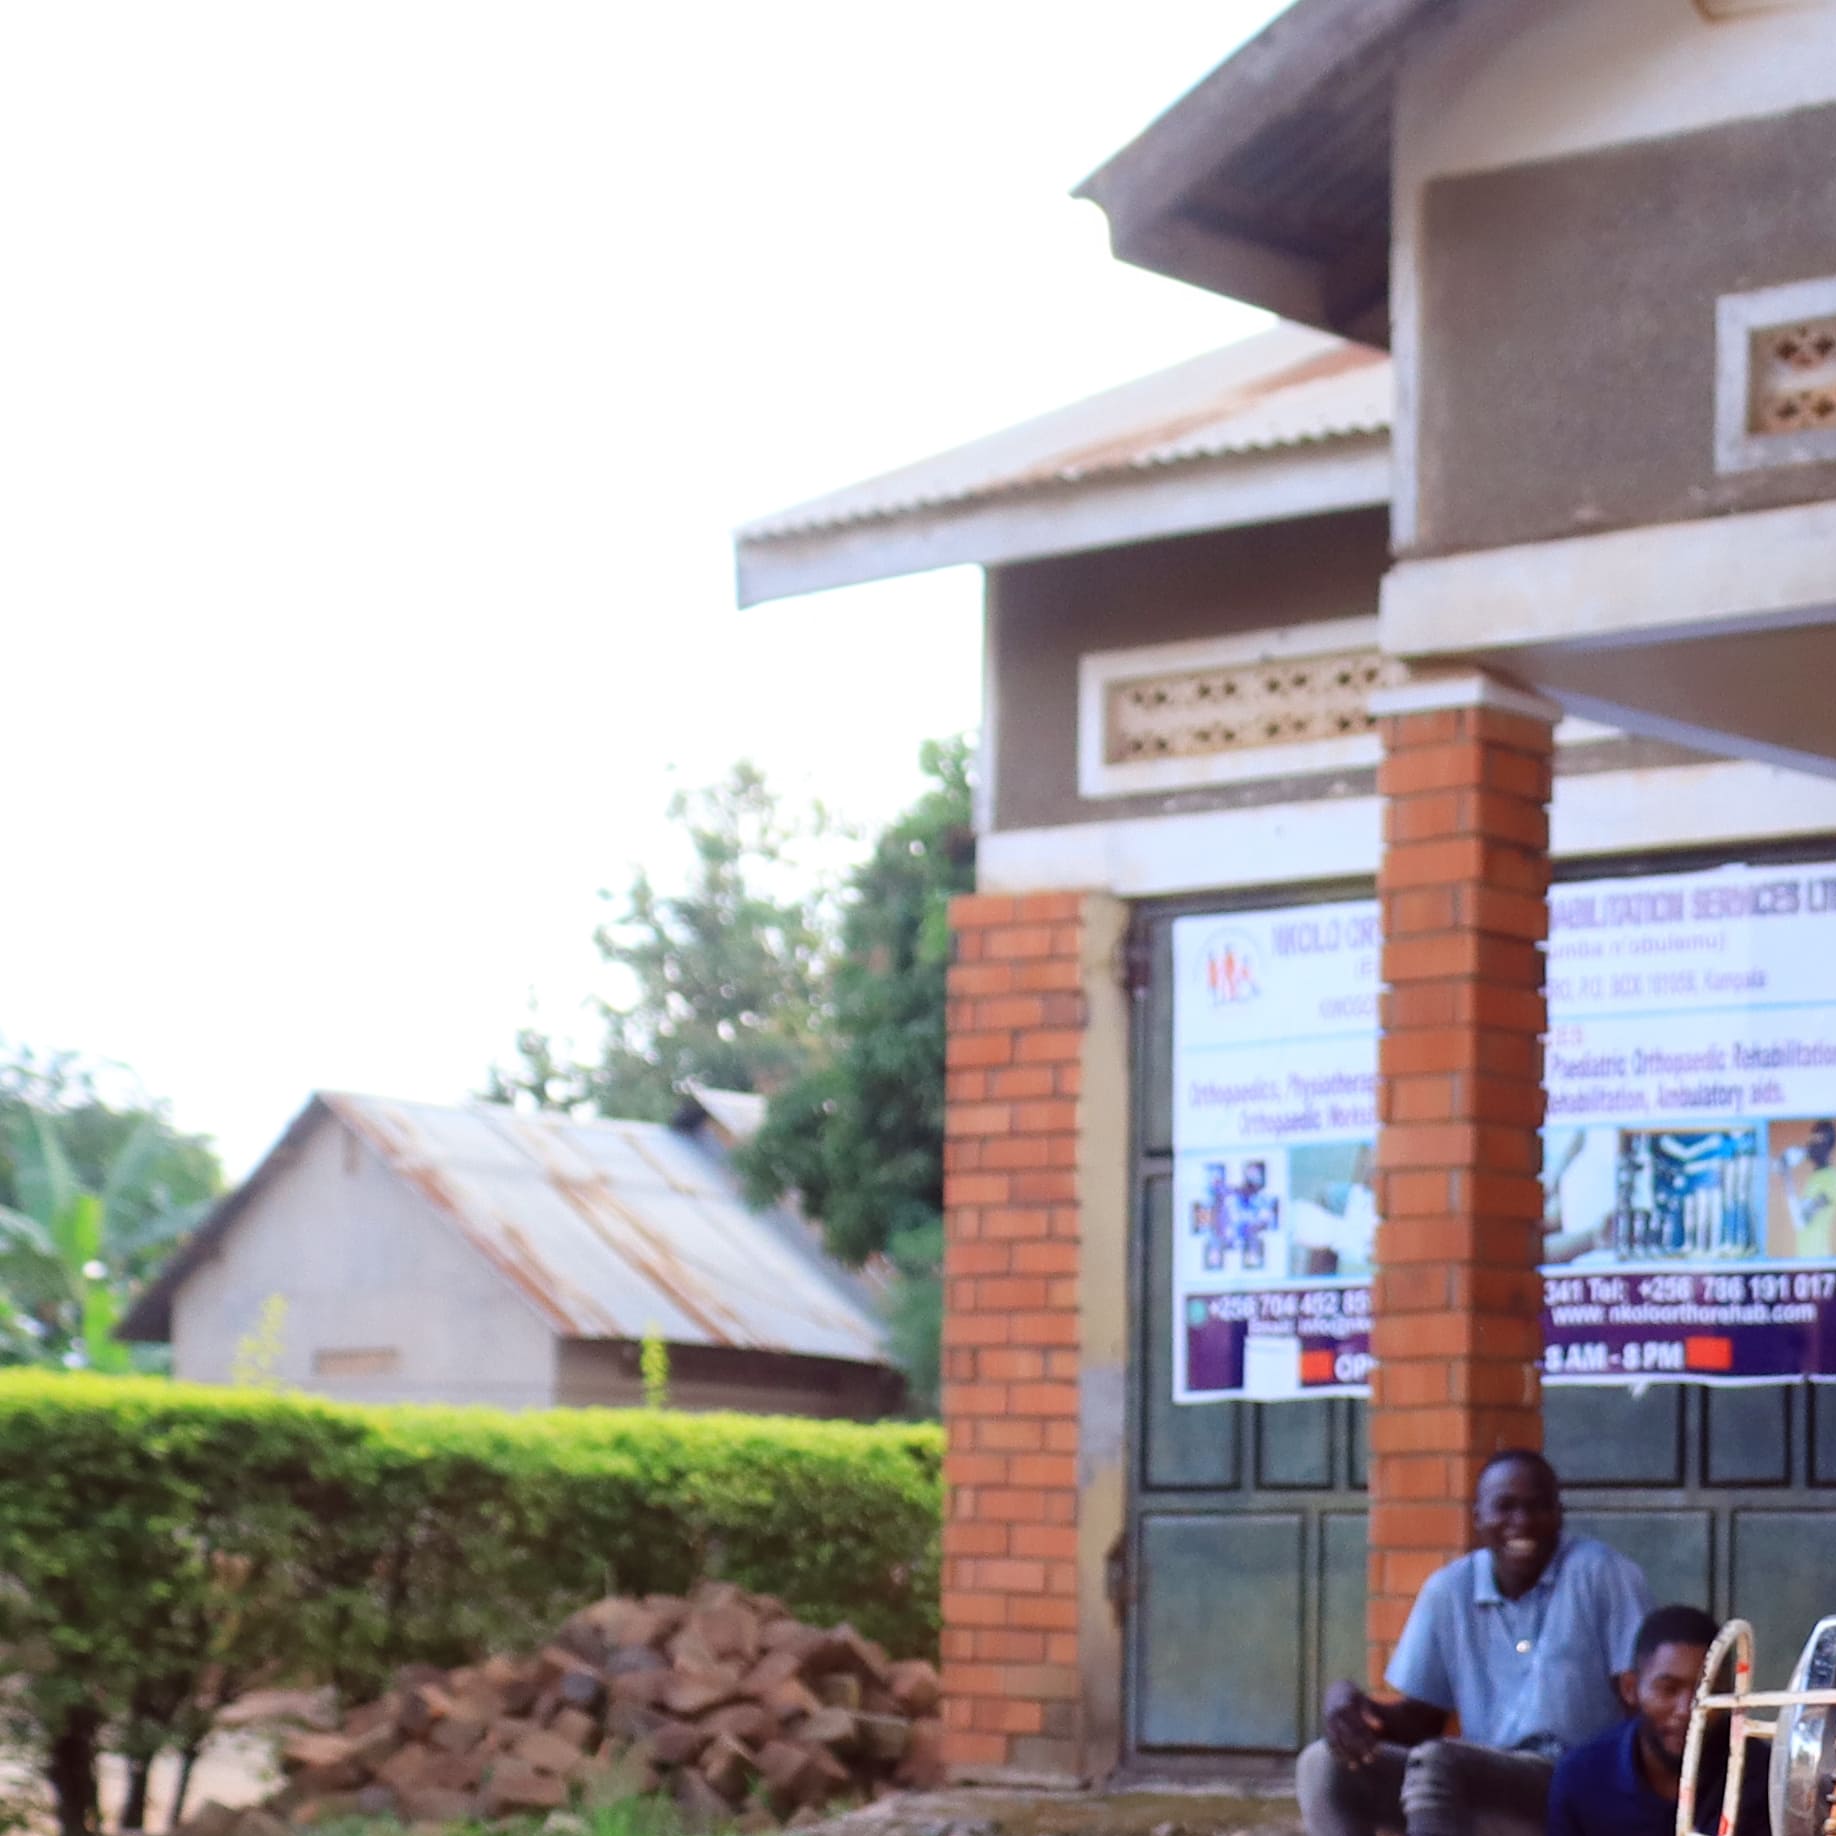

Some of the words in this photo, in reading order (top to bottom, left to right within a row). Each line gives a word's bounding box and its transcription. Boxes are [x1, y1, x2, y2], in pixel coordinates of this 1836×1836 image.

[1691, 881, 1800, 920] SERVICES
[1261, 1294, 1297, 1316] 704
[1301, 1291, 1340, 1315] 452
[1638, 1275, 1694, 1301] +256
[1702, 1274, 1745, 1300] 786
[1750, 1273, 1790, 1299] 191
[1794, 1272, 1836, 1298] 017
[1609, 1302, 1818, 1325] nkoloorthorehab.com
[1564, 1342, 1608, 1370] AM
[1642, 1341, 1685, 1369] PM
